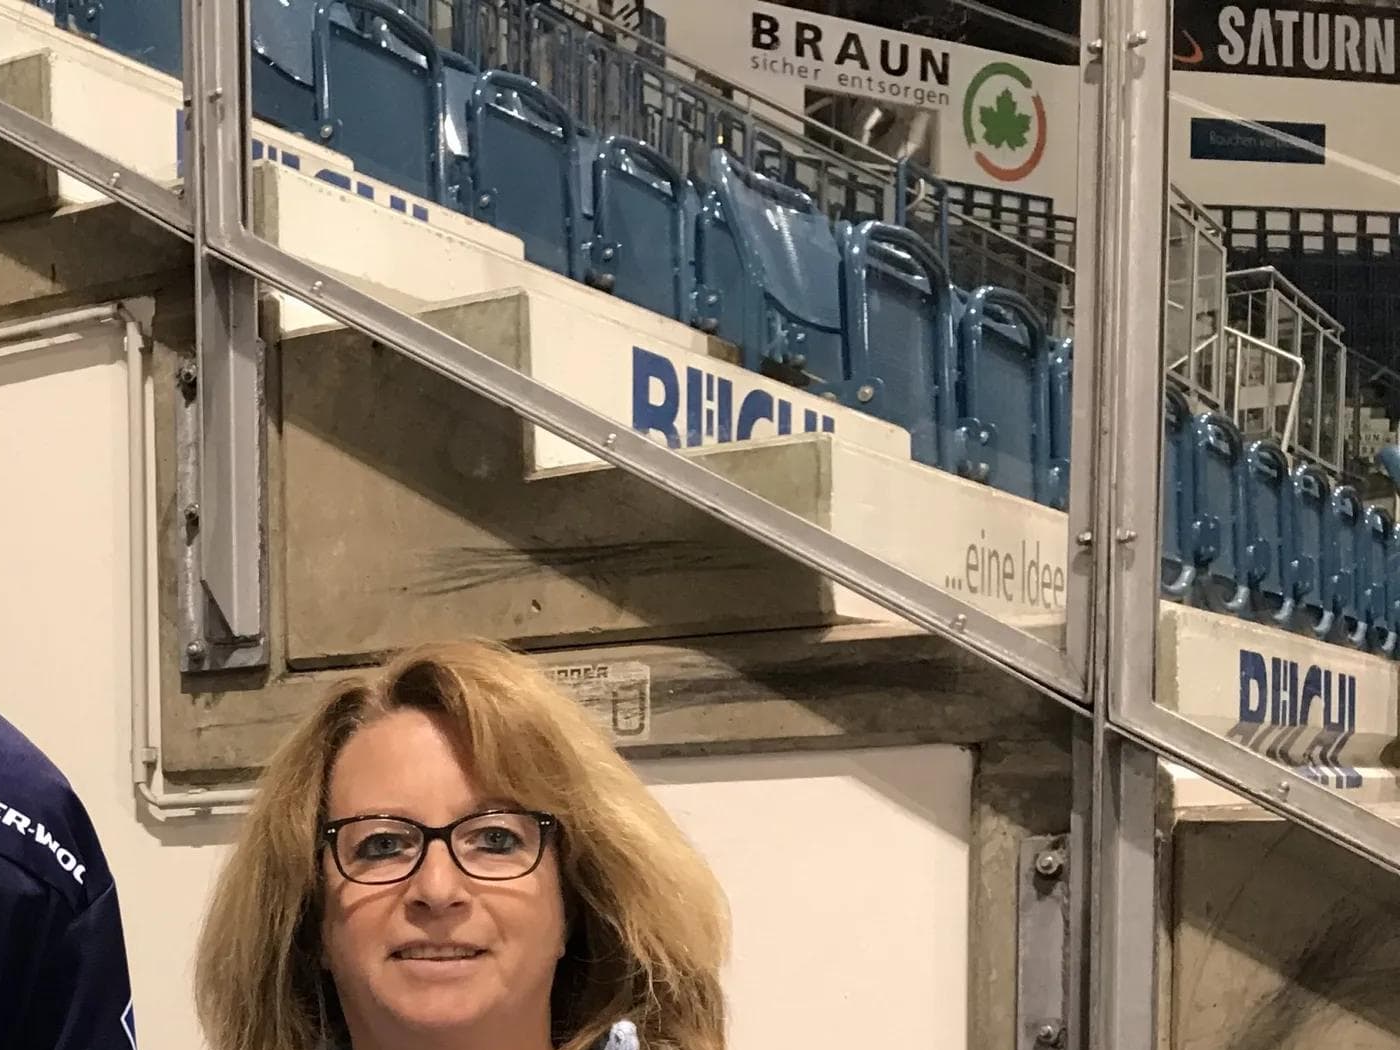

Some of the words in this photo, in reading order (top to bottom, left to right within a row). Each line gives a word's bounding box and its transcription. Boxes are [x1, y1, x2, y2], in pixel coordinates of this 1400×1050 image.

[752, 12, 950, 86] BRAUN
[1217, 5, 1396, 74] SATURN
[750, 54, 822, 80] sicher
[837, 72, 949, 105] entsorgen
[1021, 539, 1065, 609] Idee
